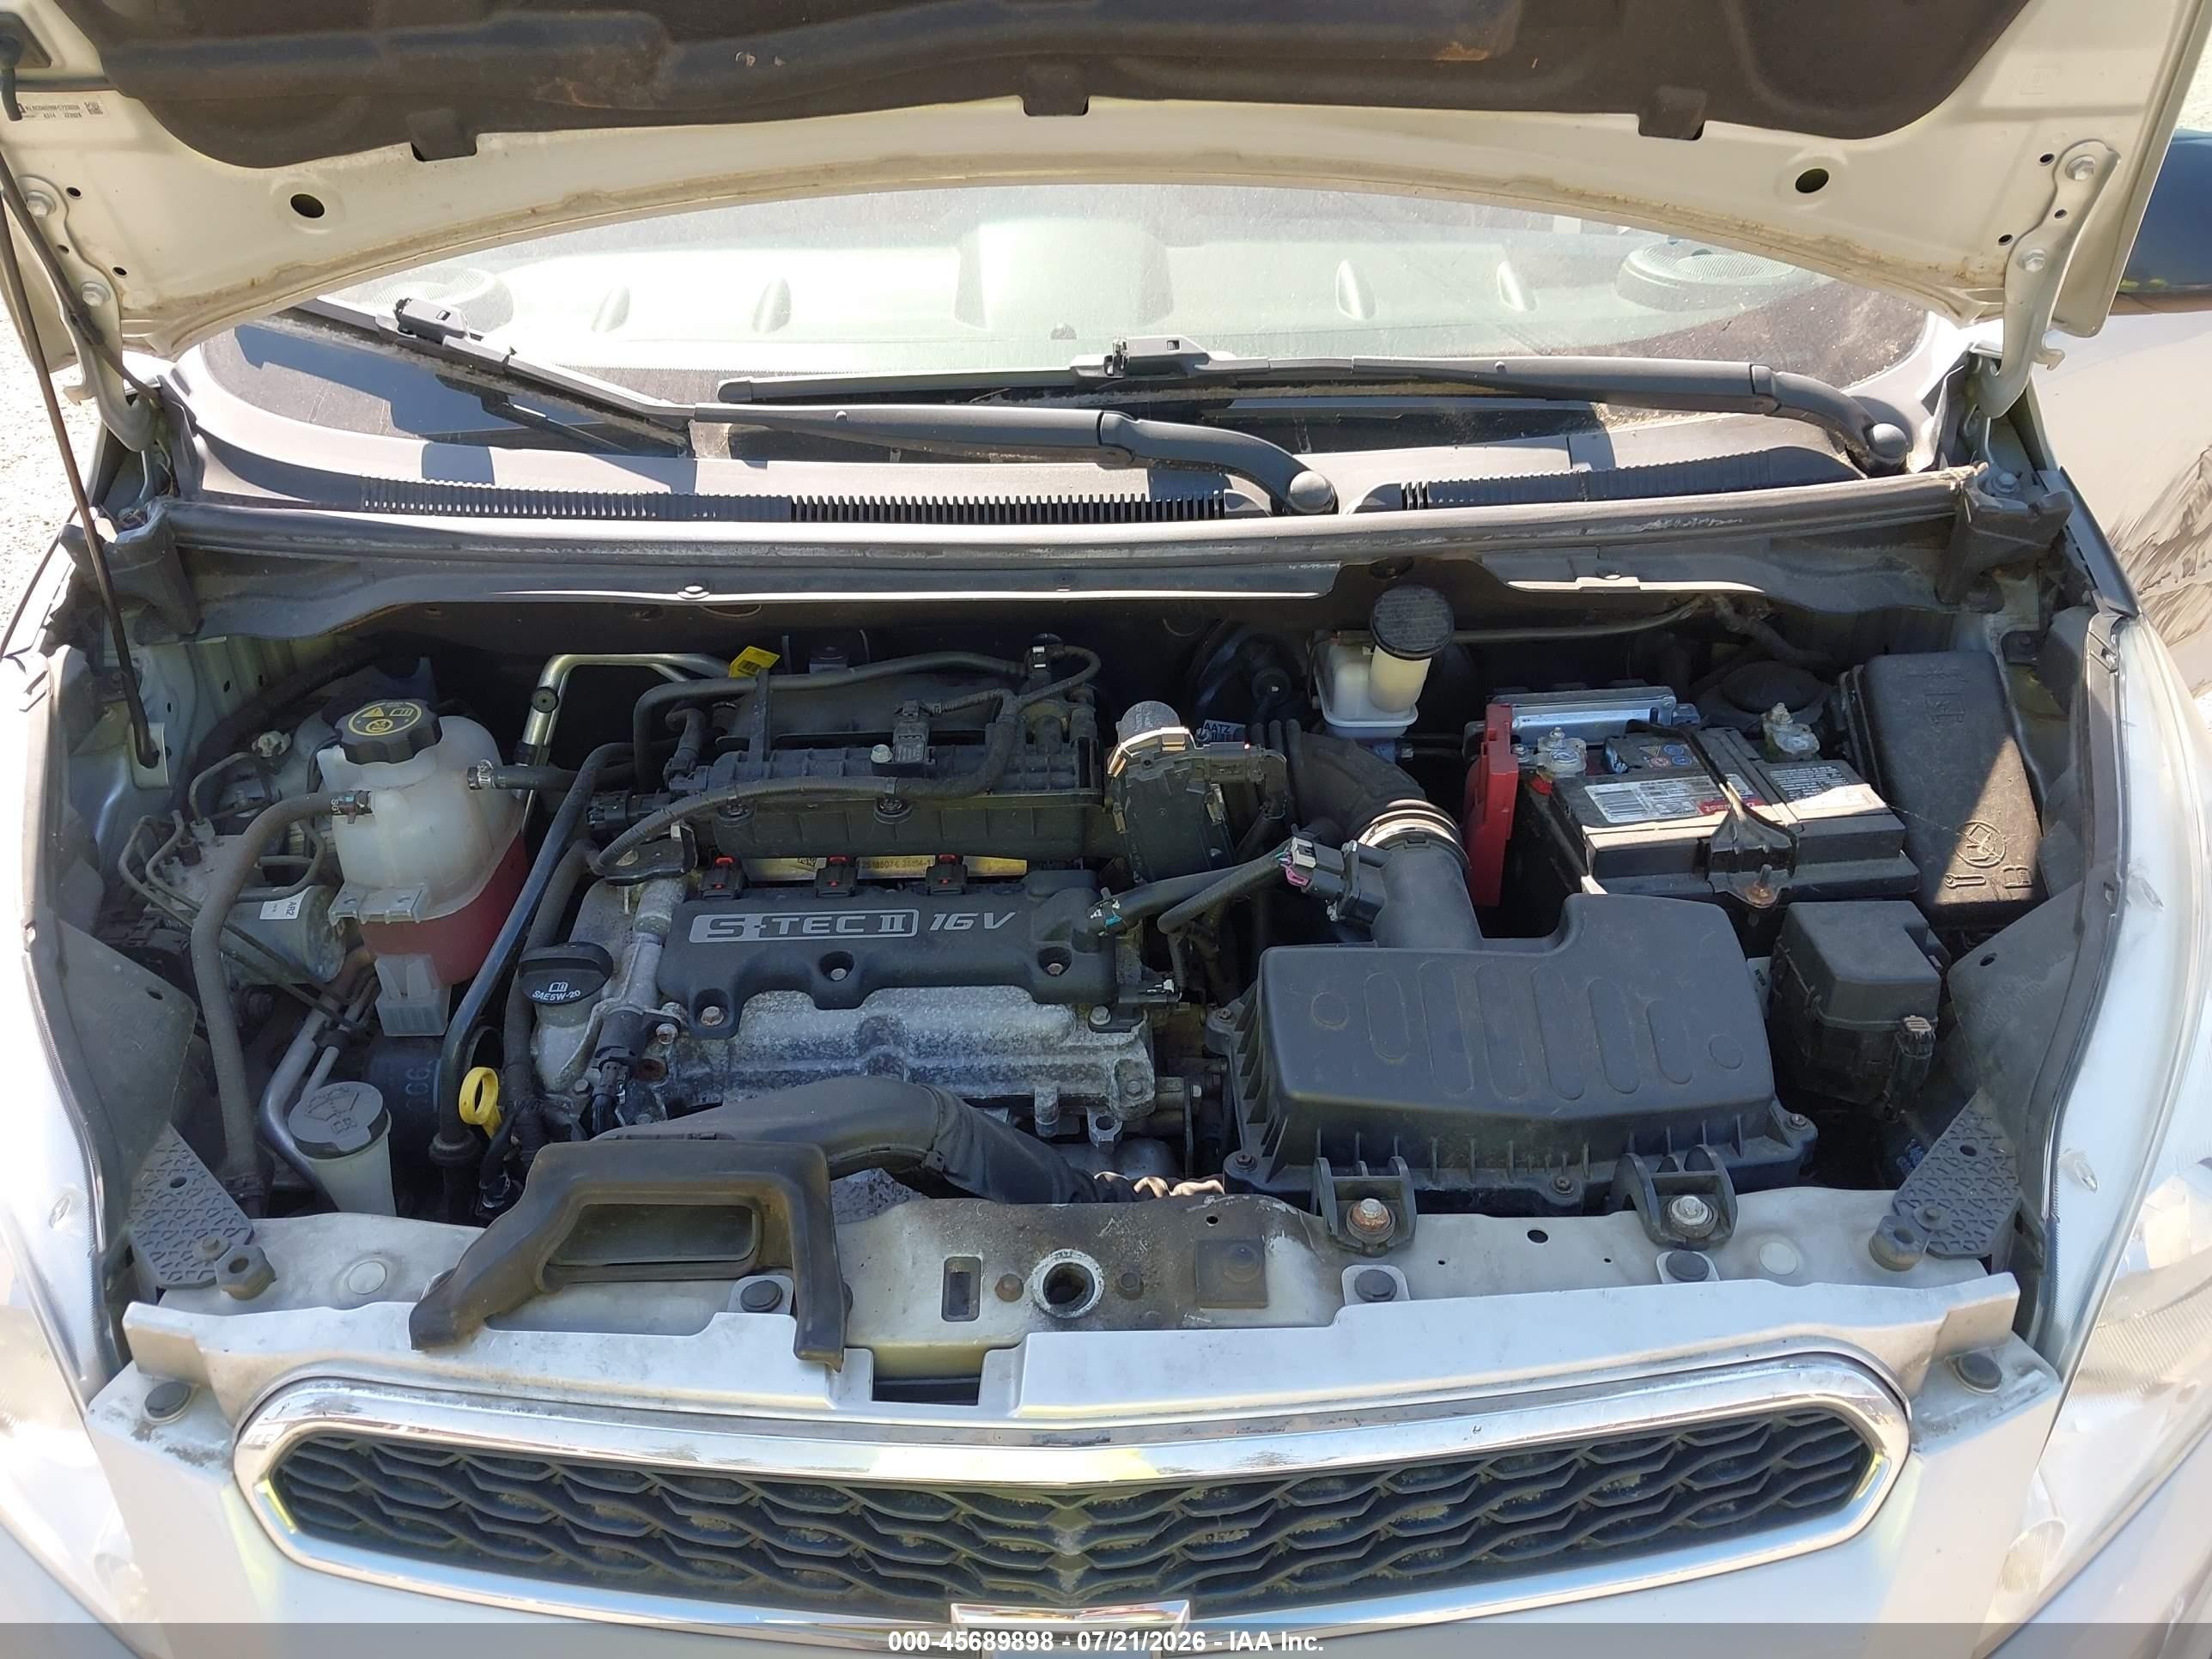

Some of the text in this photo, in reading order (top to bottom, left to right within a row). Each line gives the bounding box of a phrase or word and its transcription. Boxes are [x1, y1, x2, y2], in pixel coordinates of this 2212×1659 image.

[1204, 722, 1230, 733] AATZ
[286, 902, 296, 915] AR2
[929, 912, 1017, 932] 16V
